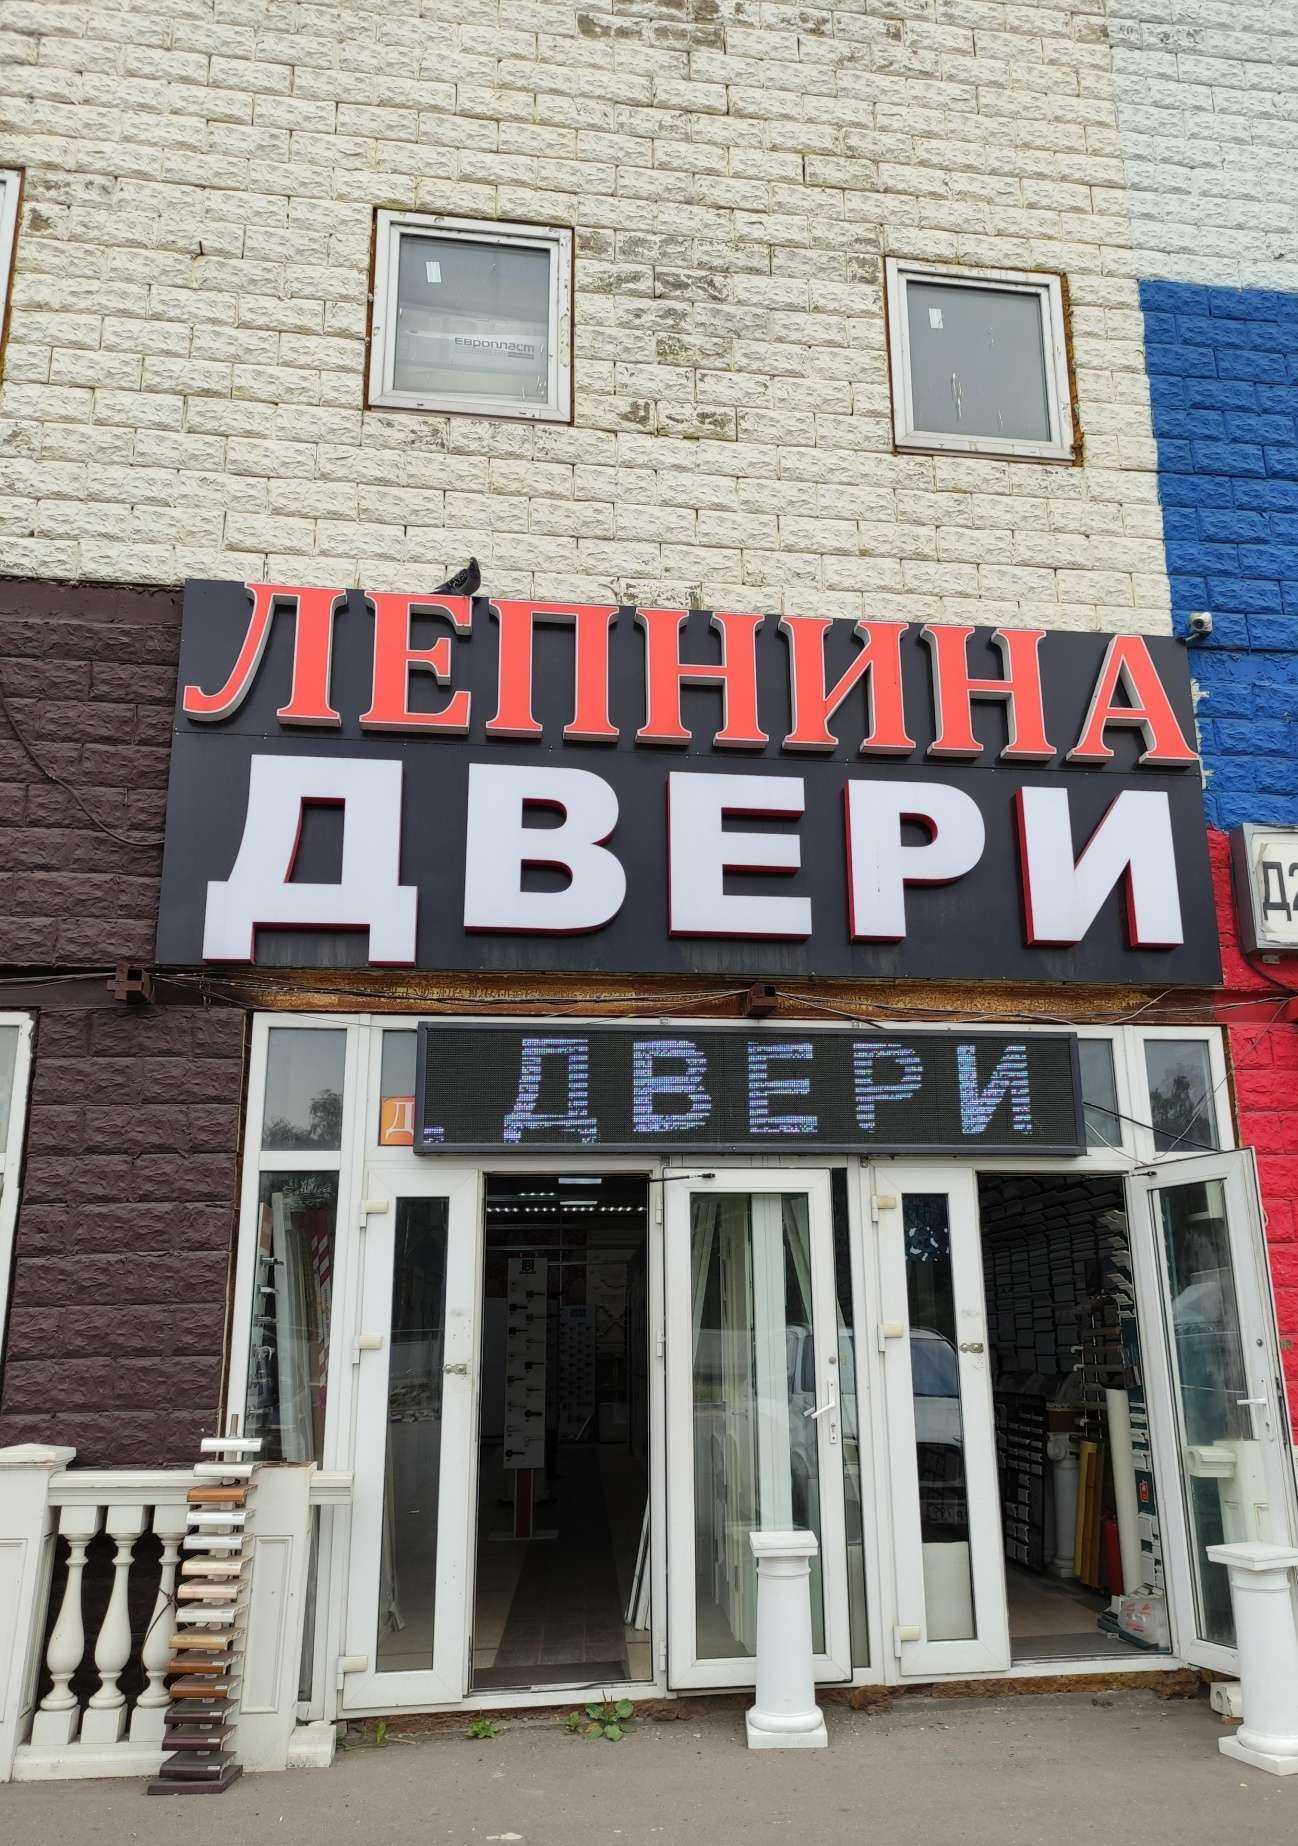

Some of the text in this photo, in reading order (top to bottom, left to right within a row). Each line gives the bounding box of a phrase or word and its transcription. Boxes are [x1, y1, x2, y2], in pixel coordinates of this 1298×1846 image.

[183, 582, 1199, 766] ЛЕПНИНА
[201, 753, 1185, 965] ДВЕРИ
[502, 1037, 1034, 1143] ДВЕРИ
